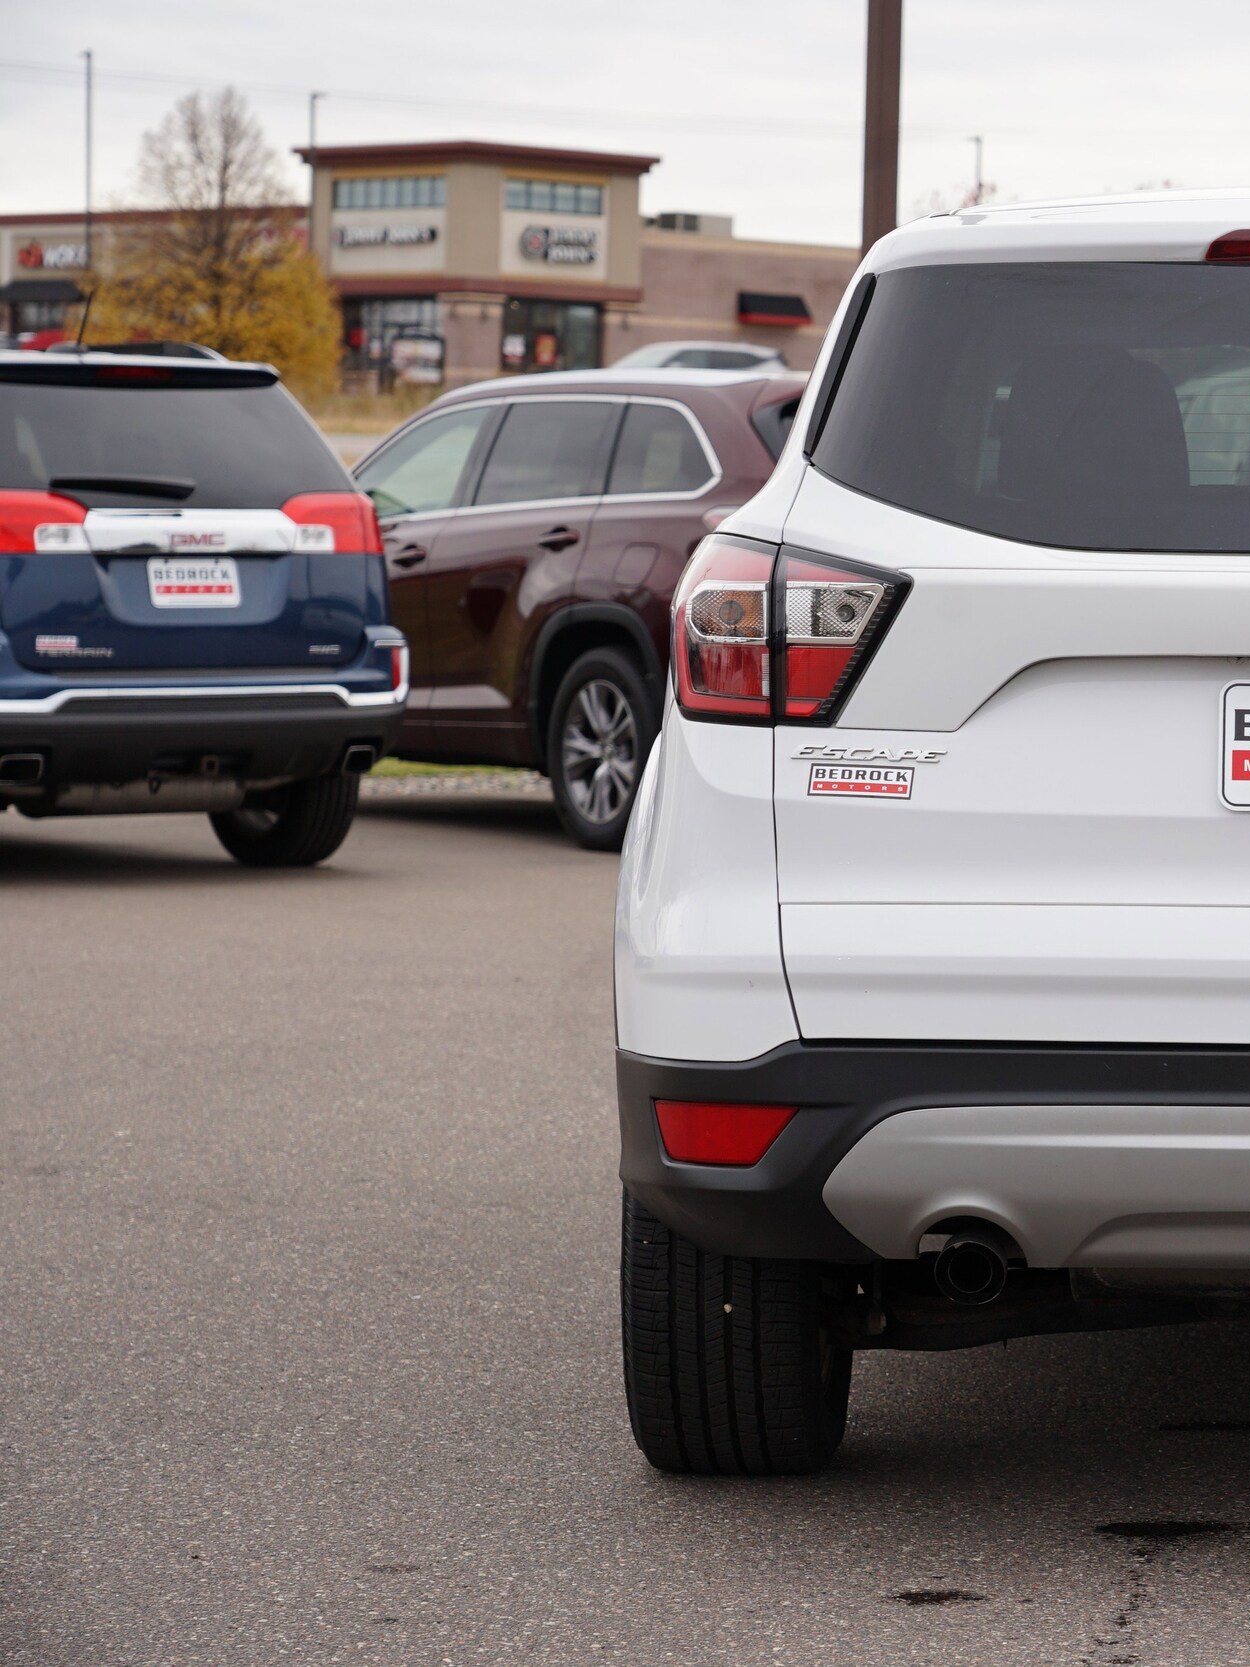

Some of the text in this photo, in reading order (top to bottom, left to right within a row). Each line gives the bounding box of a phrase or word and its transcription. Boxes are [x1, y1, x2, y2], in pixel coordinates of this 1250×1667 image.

[171, 533, 225, 546] GMC
[790, 743, 948, 763] ESCAPE
[814, 768, 909, 782] BEDROCK
[816, 783, 904, 792] MOTORS
